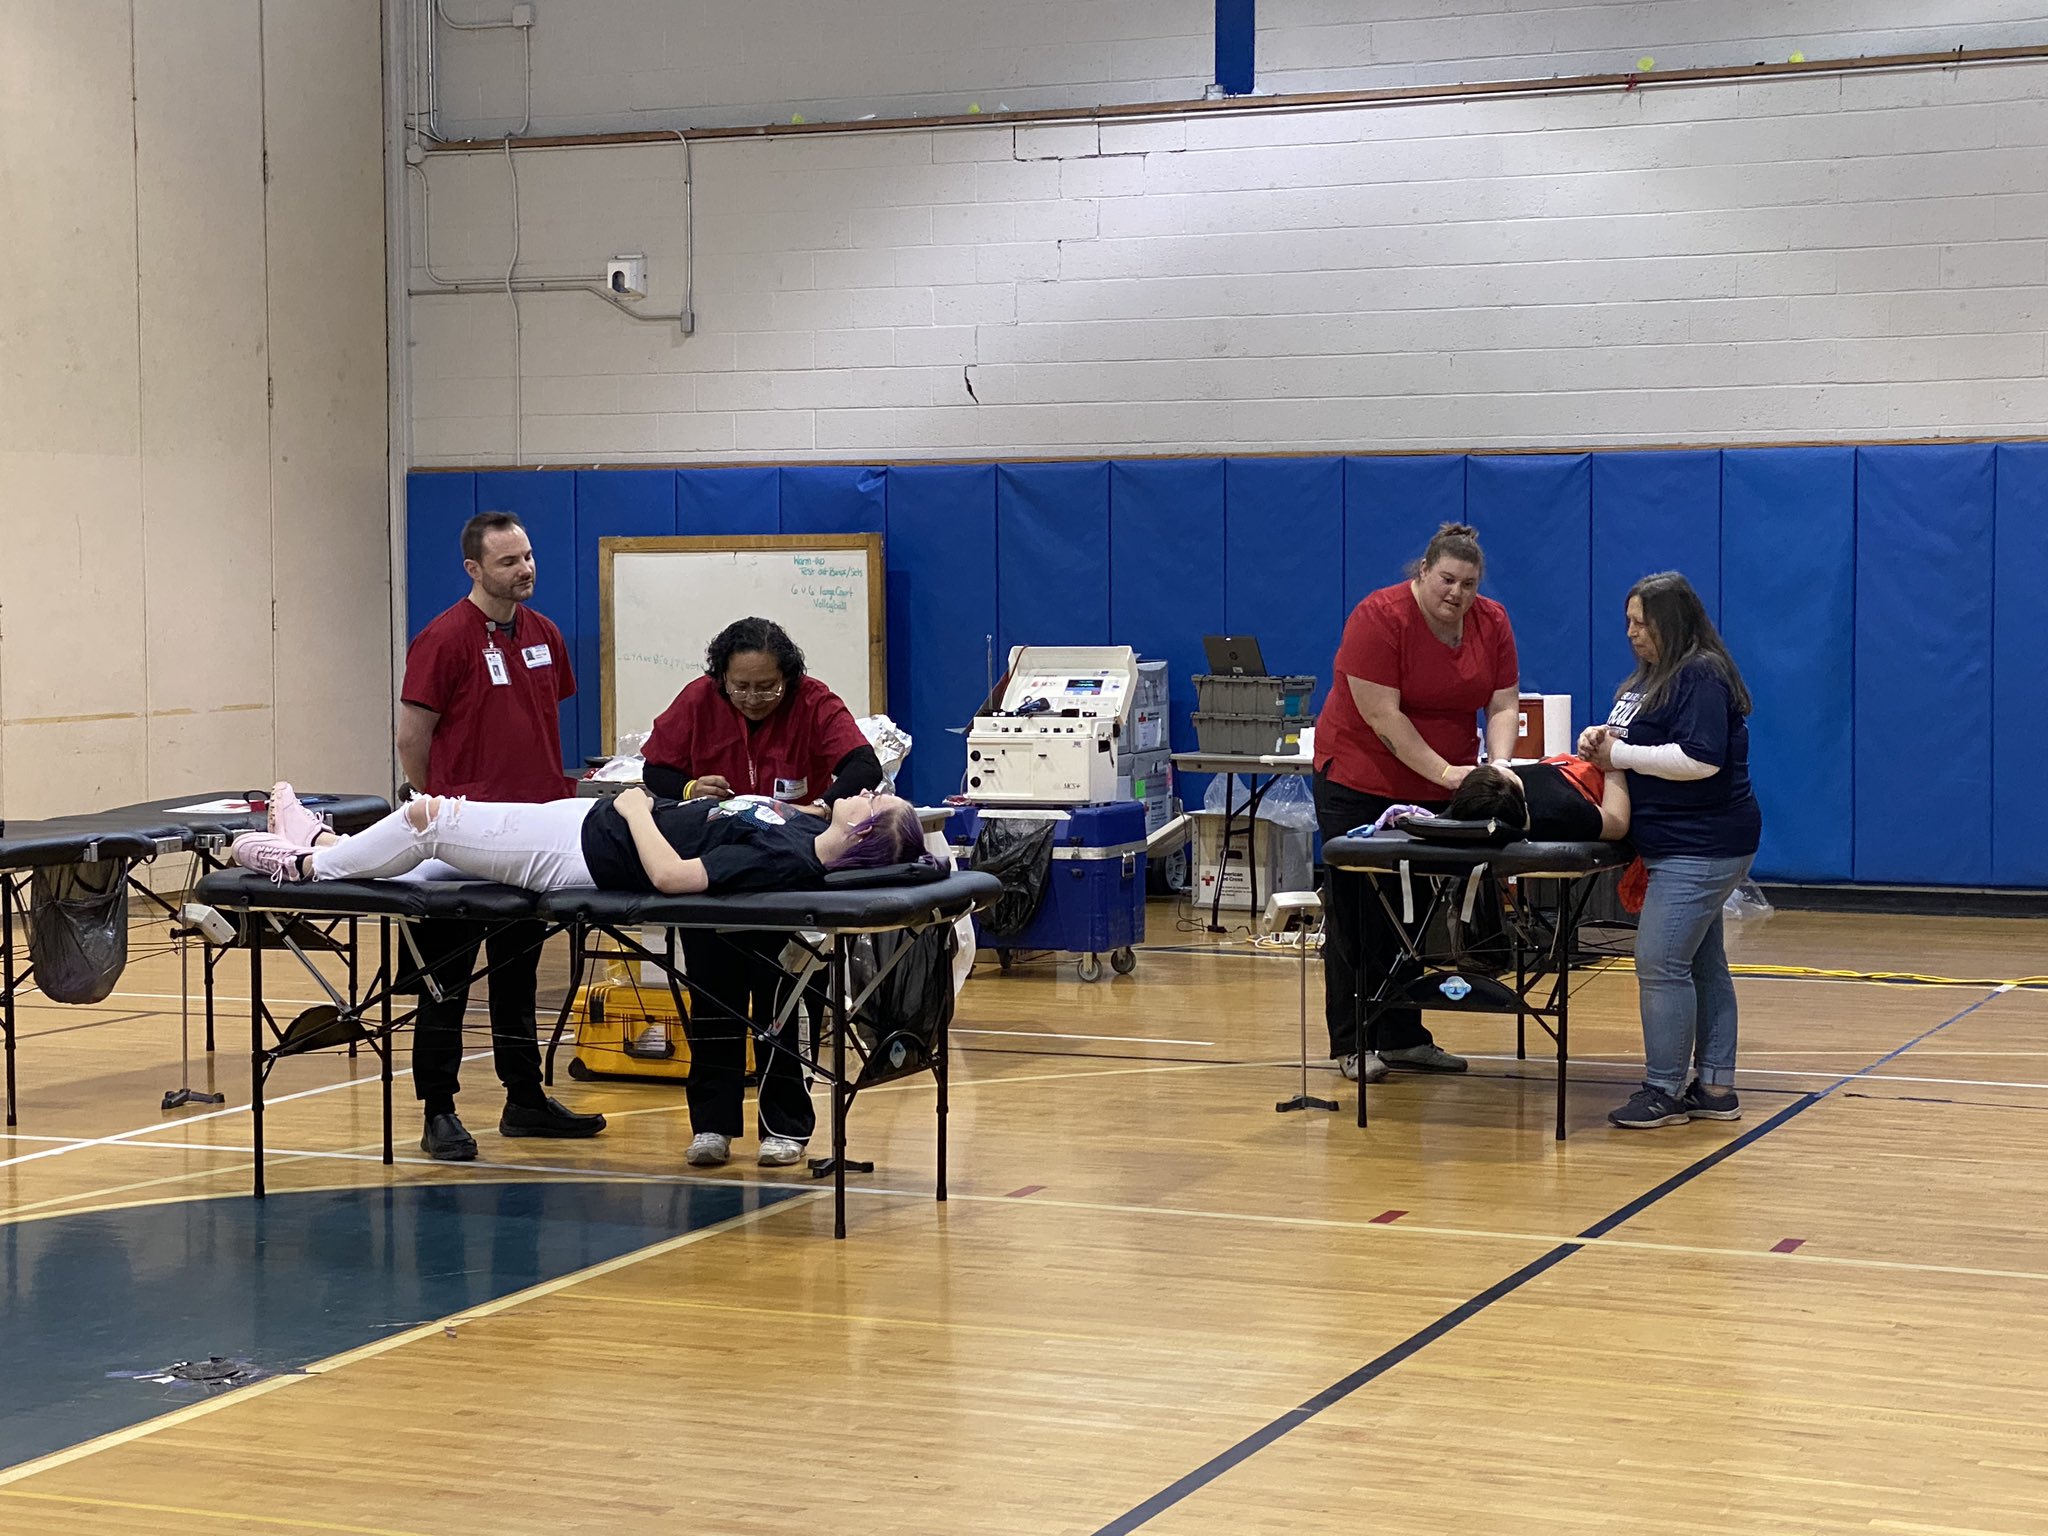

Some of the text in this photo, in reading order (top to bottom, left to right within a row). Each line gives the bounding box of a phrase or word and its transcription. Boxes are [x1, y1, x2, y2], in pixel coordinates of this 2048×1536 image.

[790, 583, 799, 595] 6
[808, 584, 815, 596] 6
[813, 599, 847, 612] Volleyball
